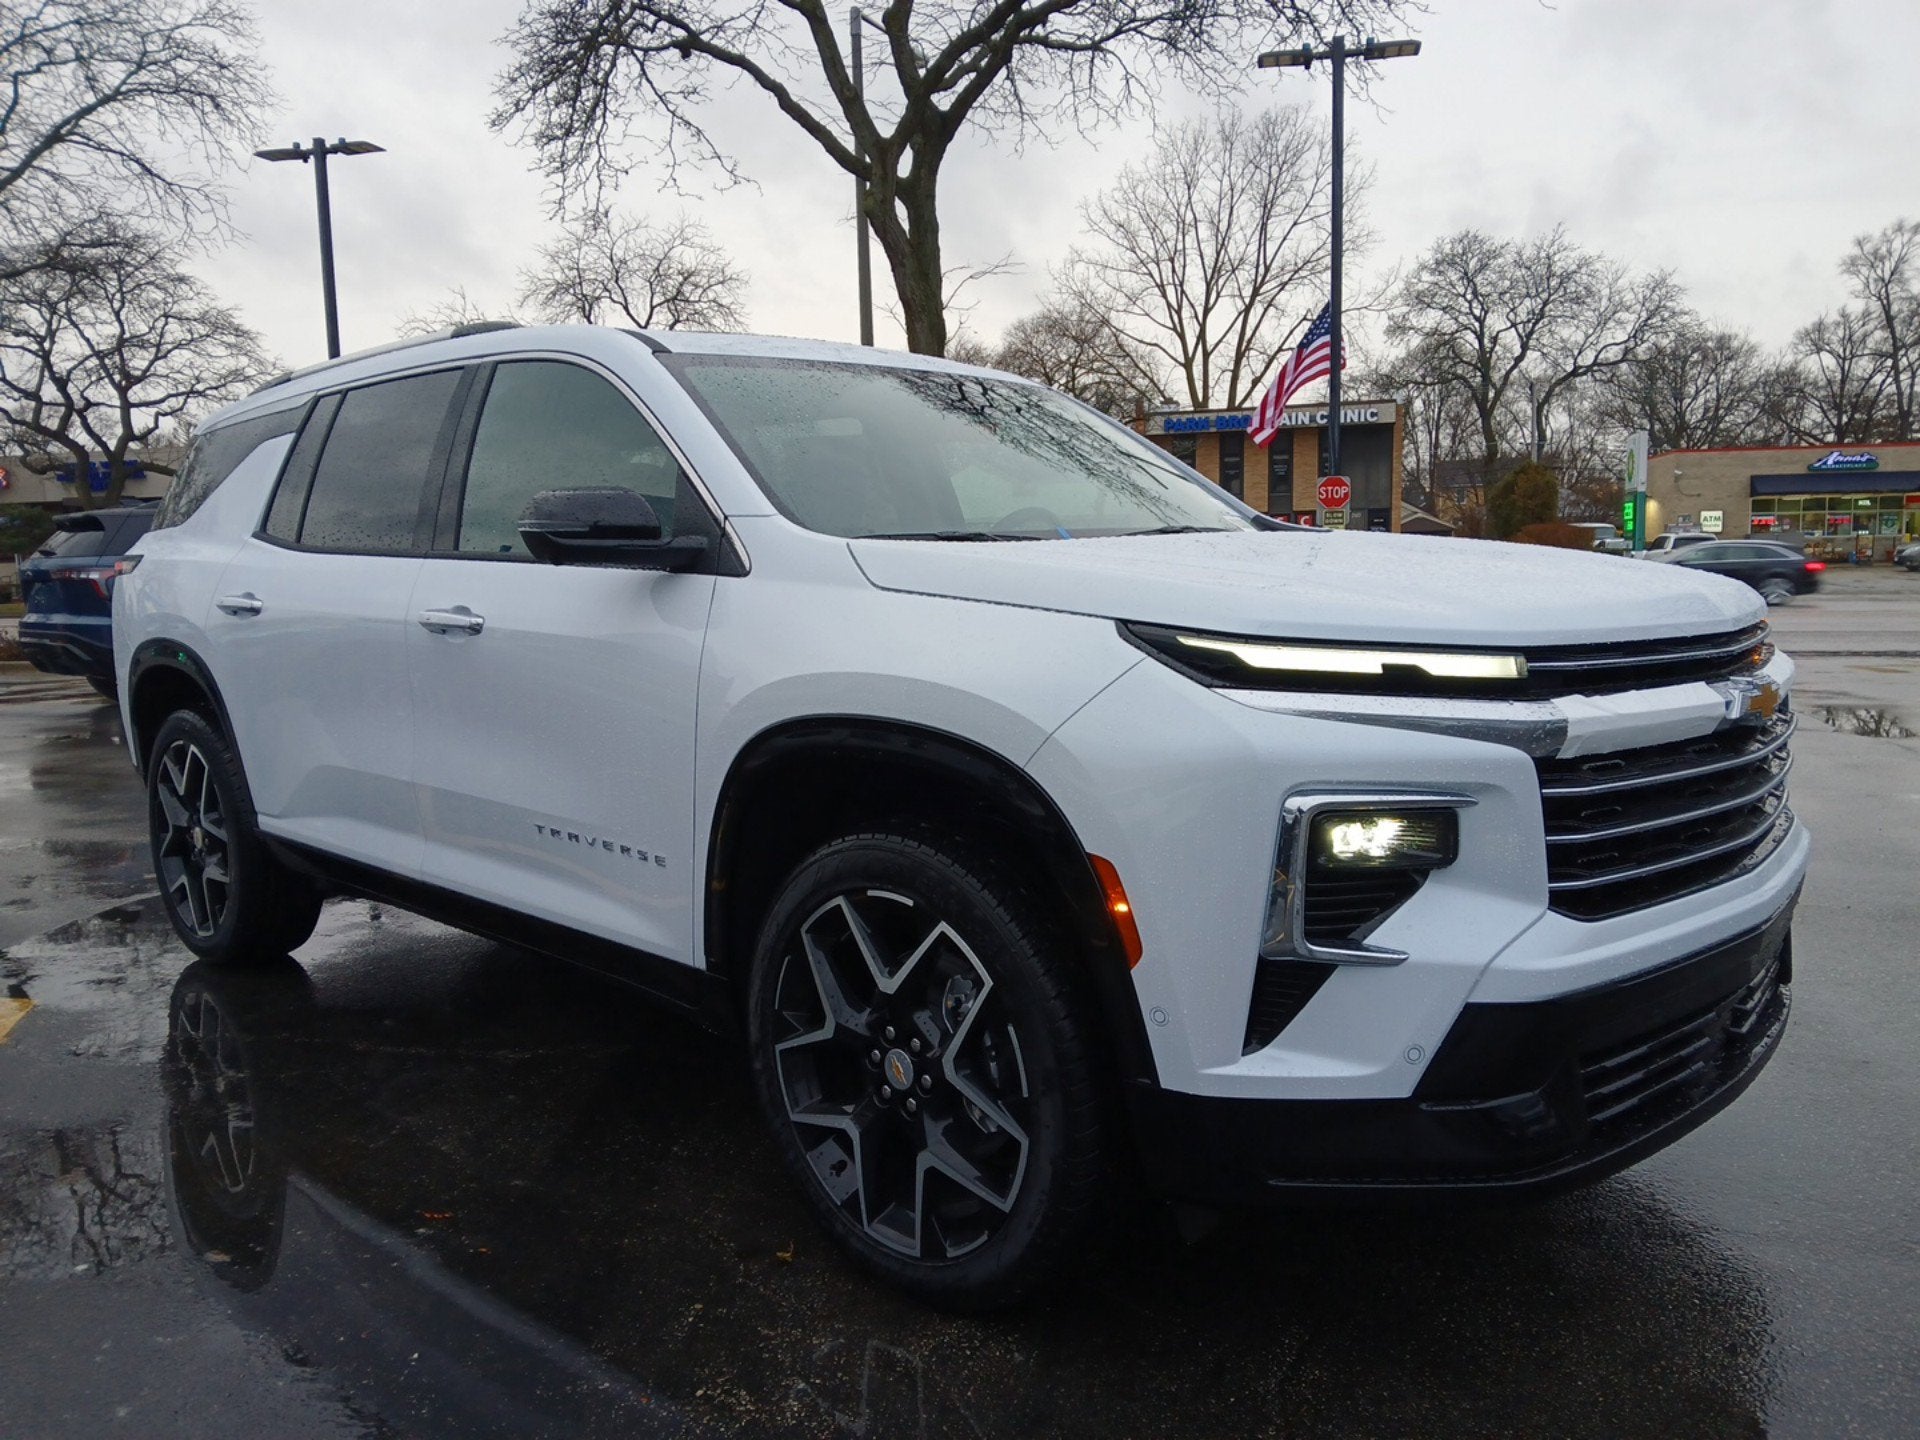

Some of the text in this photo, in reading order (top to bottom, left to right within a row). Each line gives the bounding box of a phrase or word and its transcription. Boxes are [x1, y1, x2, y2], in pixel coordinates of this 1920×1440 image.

[1163, 408, 1378, 433] PARK BRO AIN CINIC
[1319, 486, 1349, 499] STOP
[1702, 515, 1721, 523] ATM
[534, 824, 666, 867] TRAVERSE
